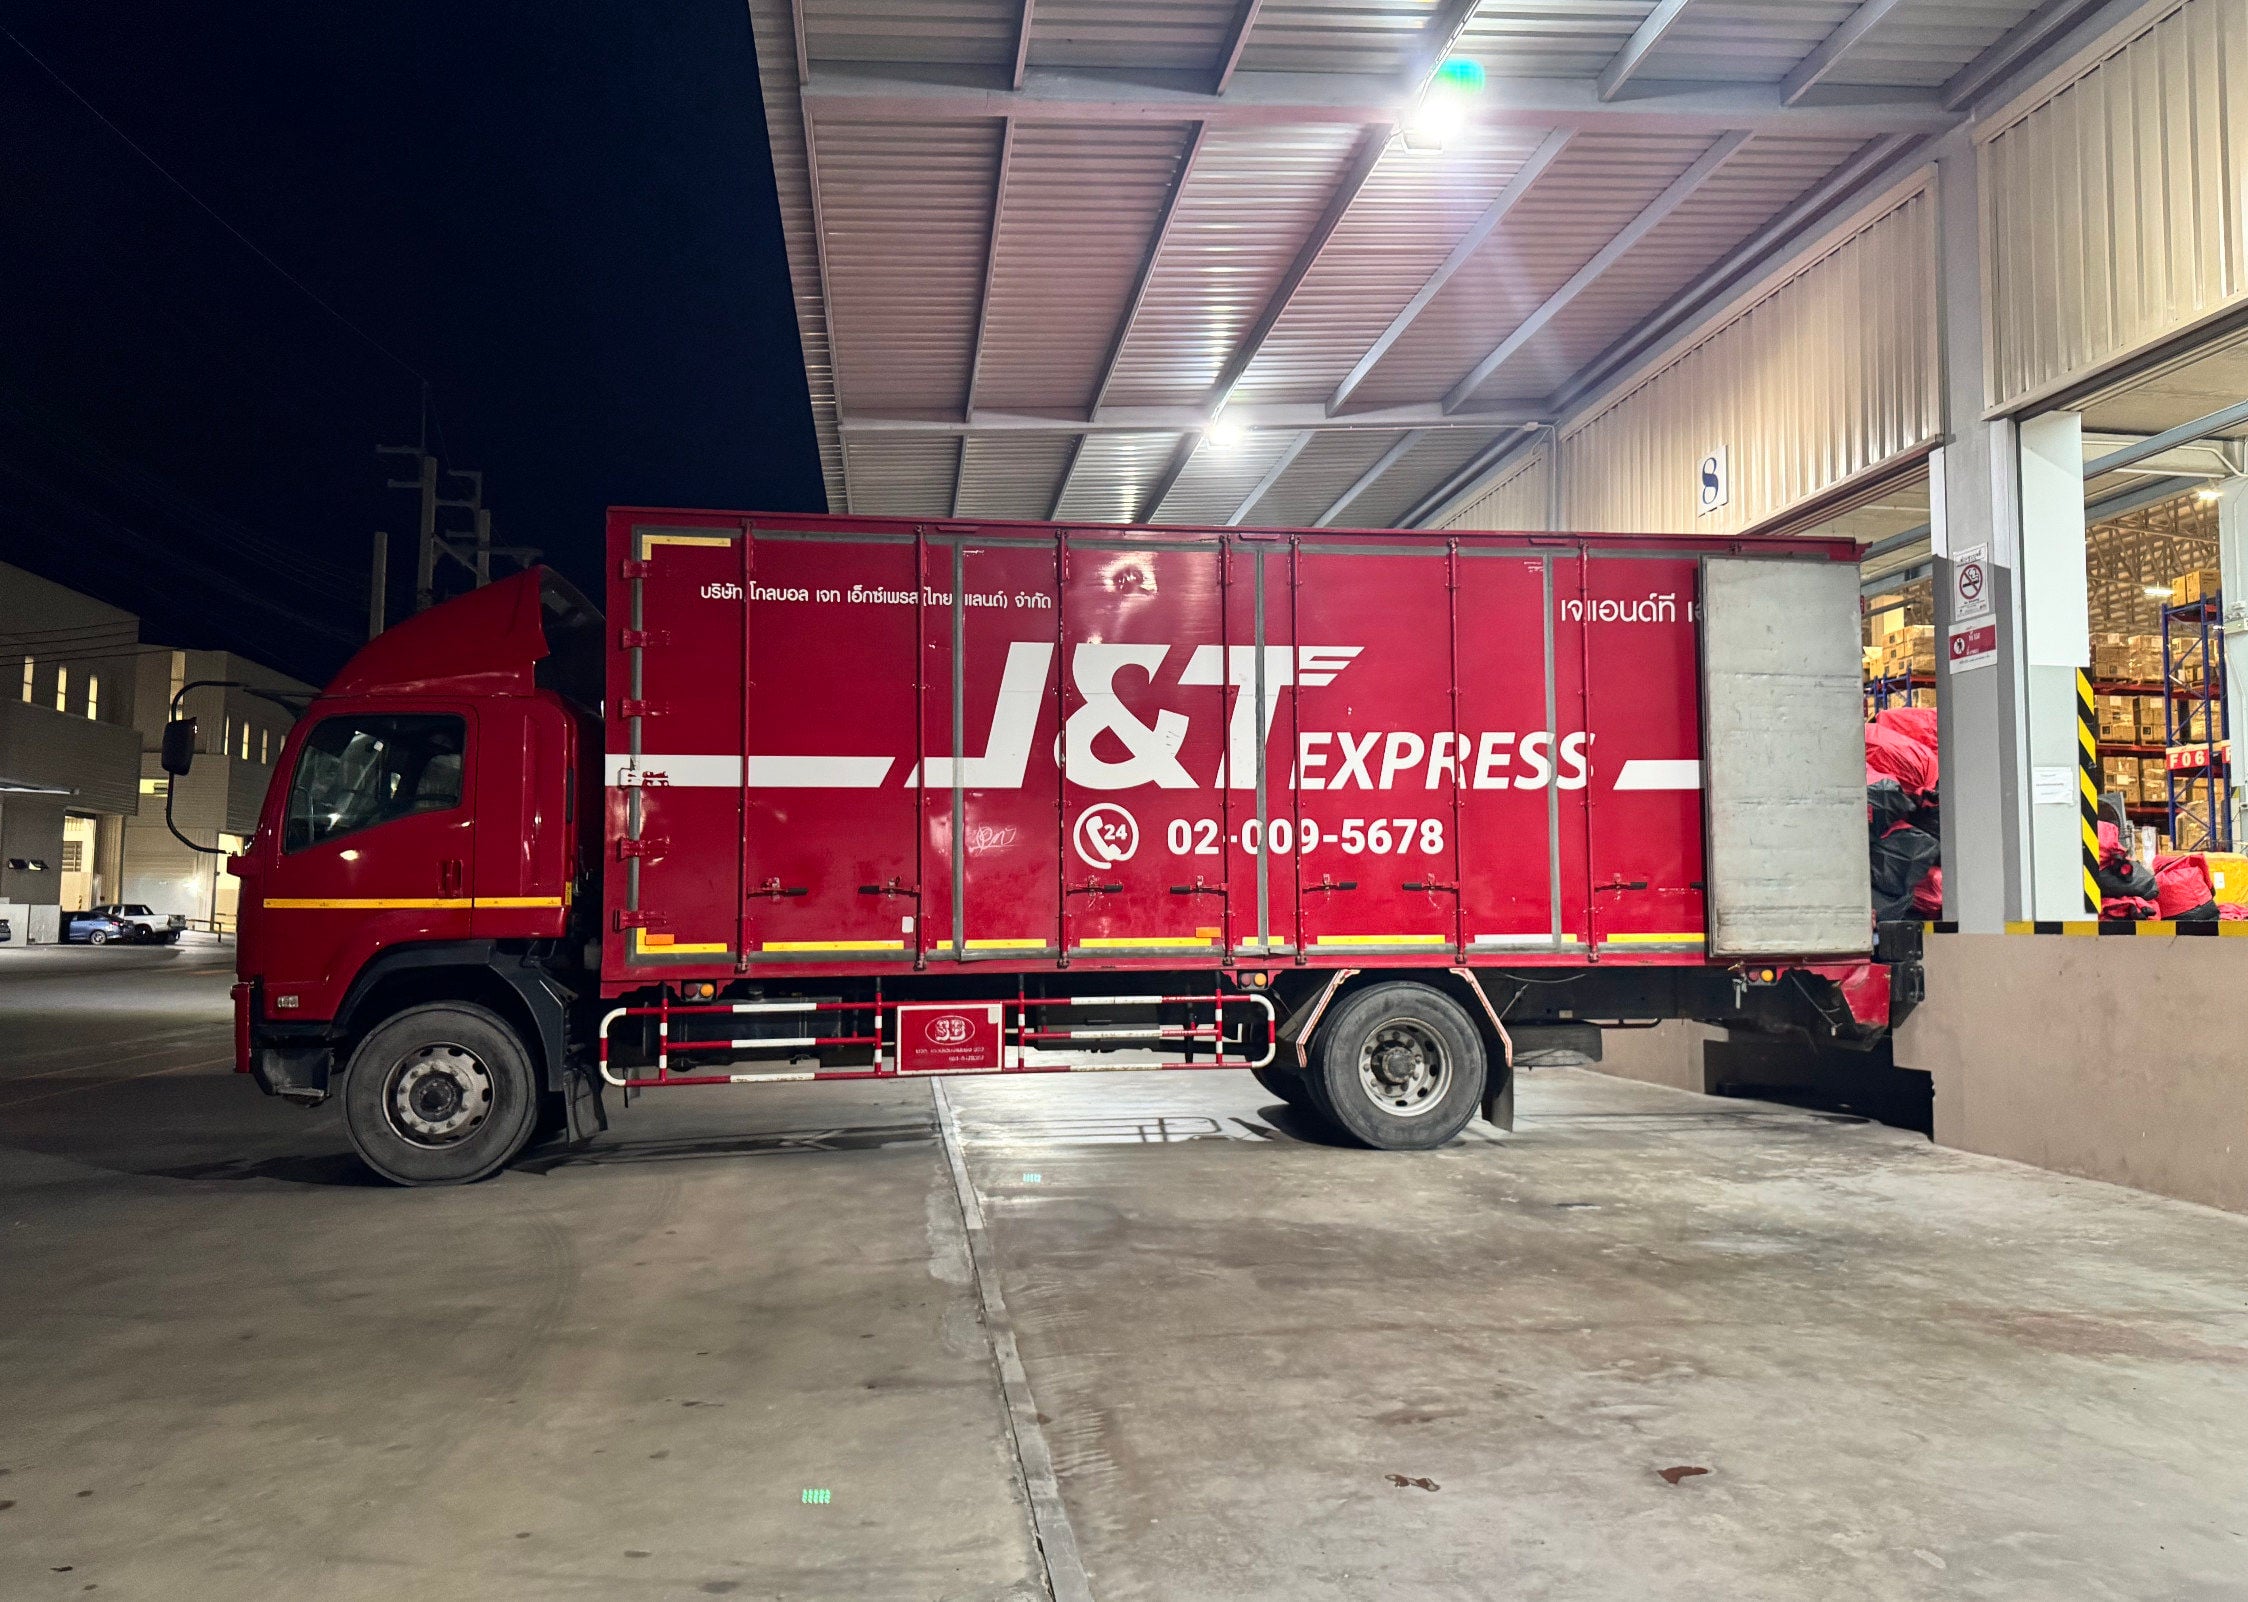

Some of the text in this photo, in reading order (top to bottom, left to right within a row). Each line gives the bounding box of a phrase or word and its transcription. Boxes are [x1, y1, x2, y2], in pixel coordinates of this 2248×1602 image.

[1702, 457, 1719, 504] 8
[700, 583, 743, 600] บริษัท
[750, 580, 809, 601] โกลบอล
[816, 589, 841, 603] เจท
[1014, 591, 1052, 608] จำกัด
[1561, 593, 1676, 622] เจแอนด์ที
[904, 642, 1596, 790] J&T EXPRESS
[1104, 824, 1128, 840] 24
[1167, 818, 1444, 855] 02-009-5678
